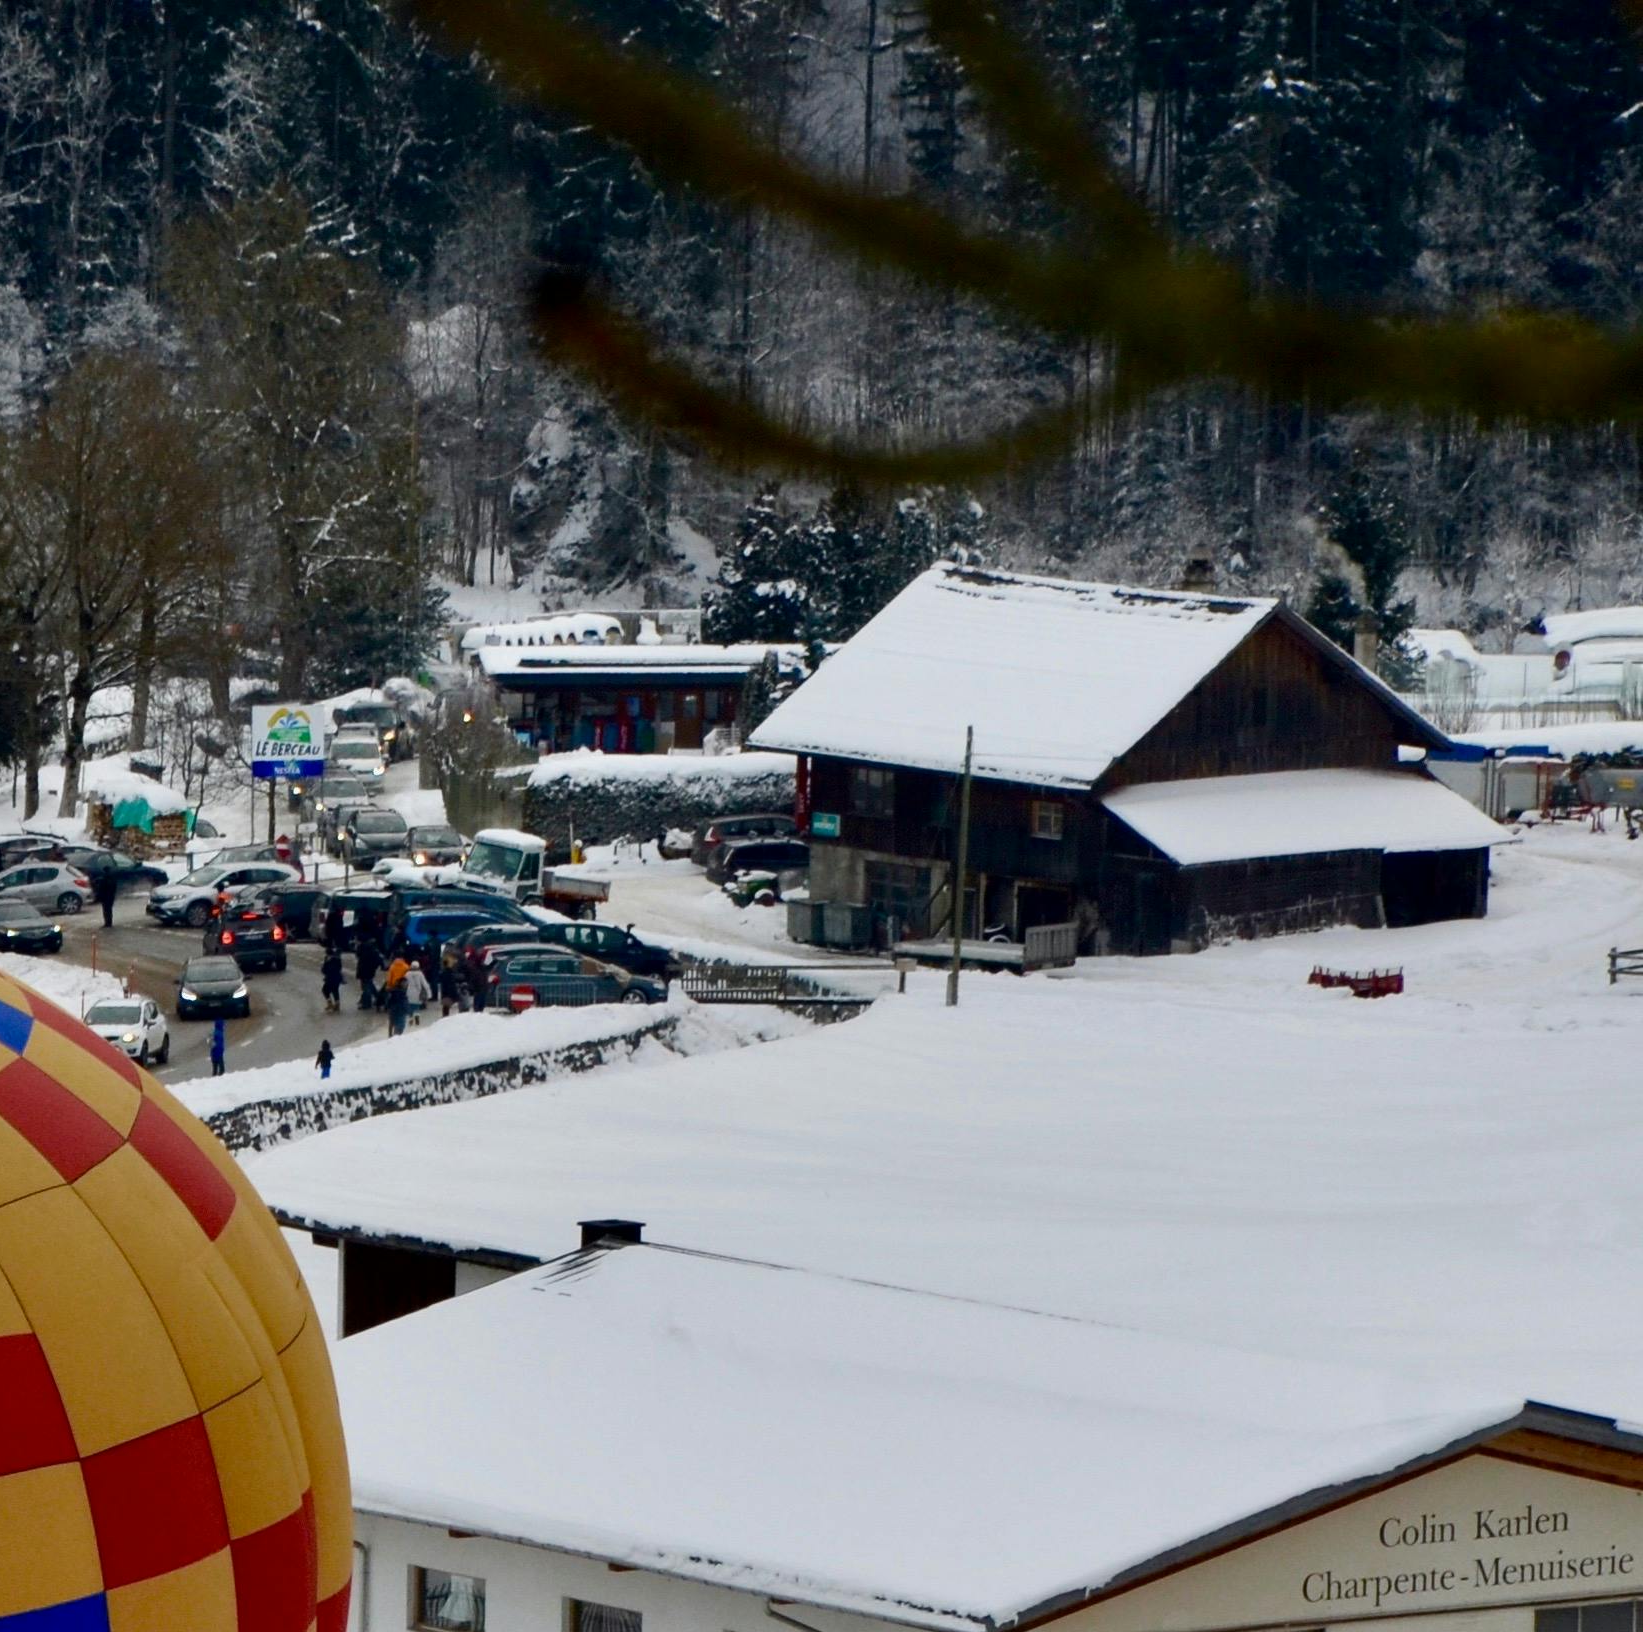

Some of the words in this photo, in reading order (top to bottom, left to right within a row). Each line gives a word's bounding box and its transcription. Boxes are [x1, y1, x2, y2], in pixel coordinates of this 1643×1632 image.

[255, 741, 269, 756] LE
[271, 742, 321, 757] BERCEAU
[1379, 1514, 1455, 1548] Colin
[1474, 1505, 1569, 1540] Karlen
